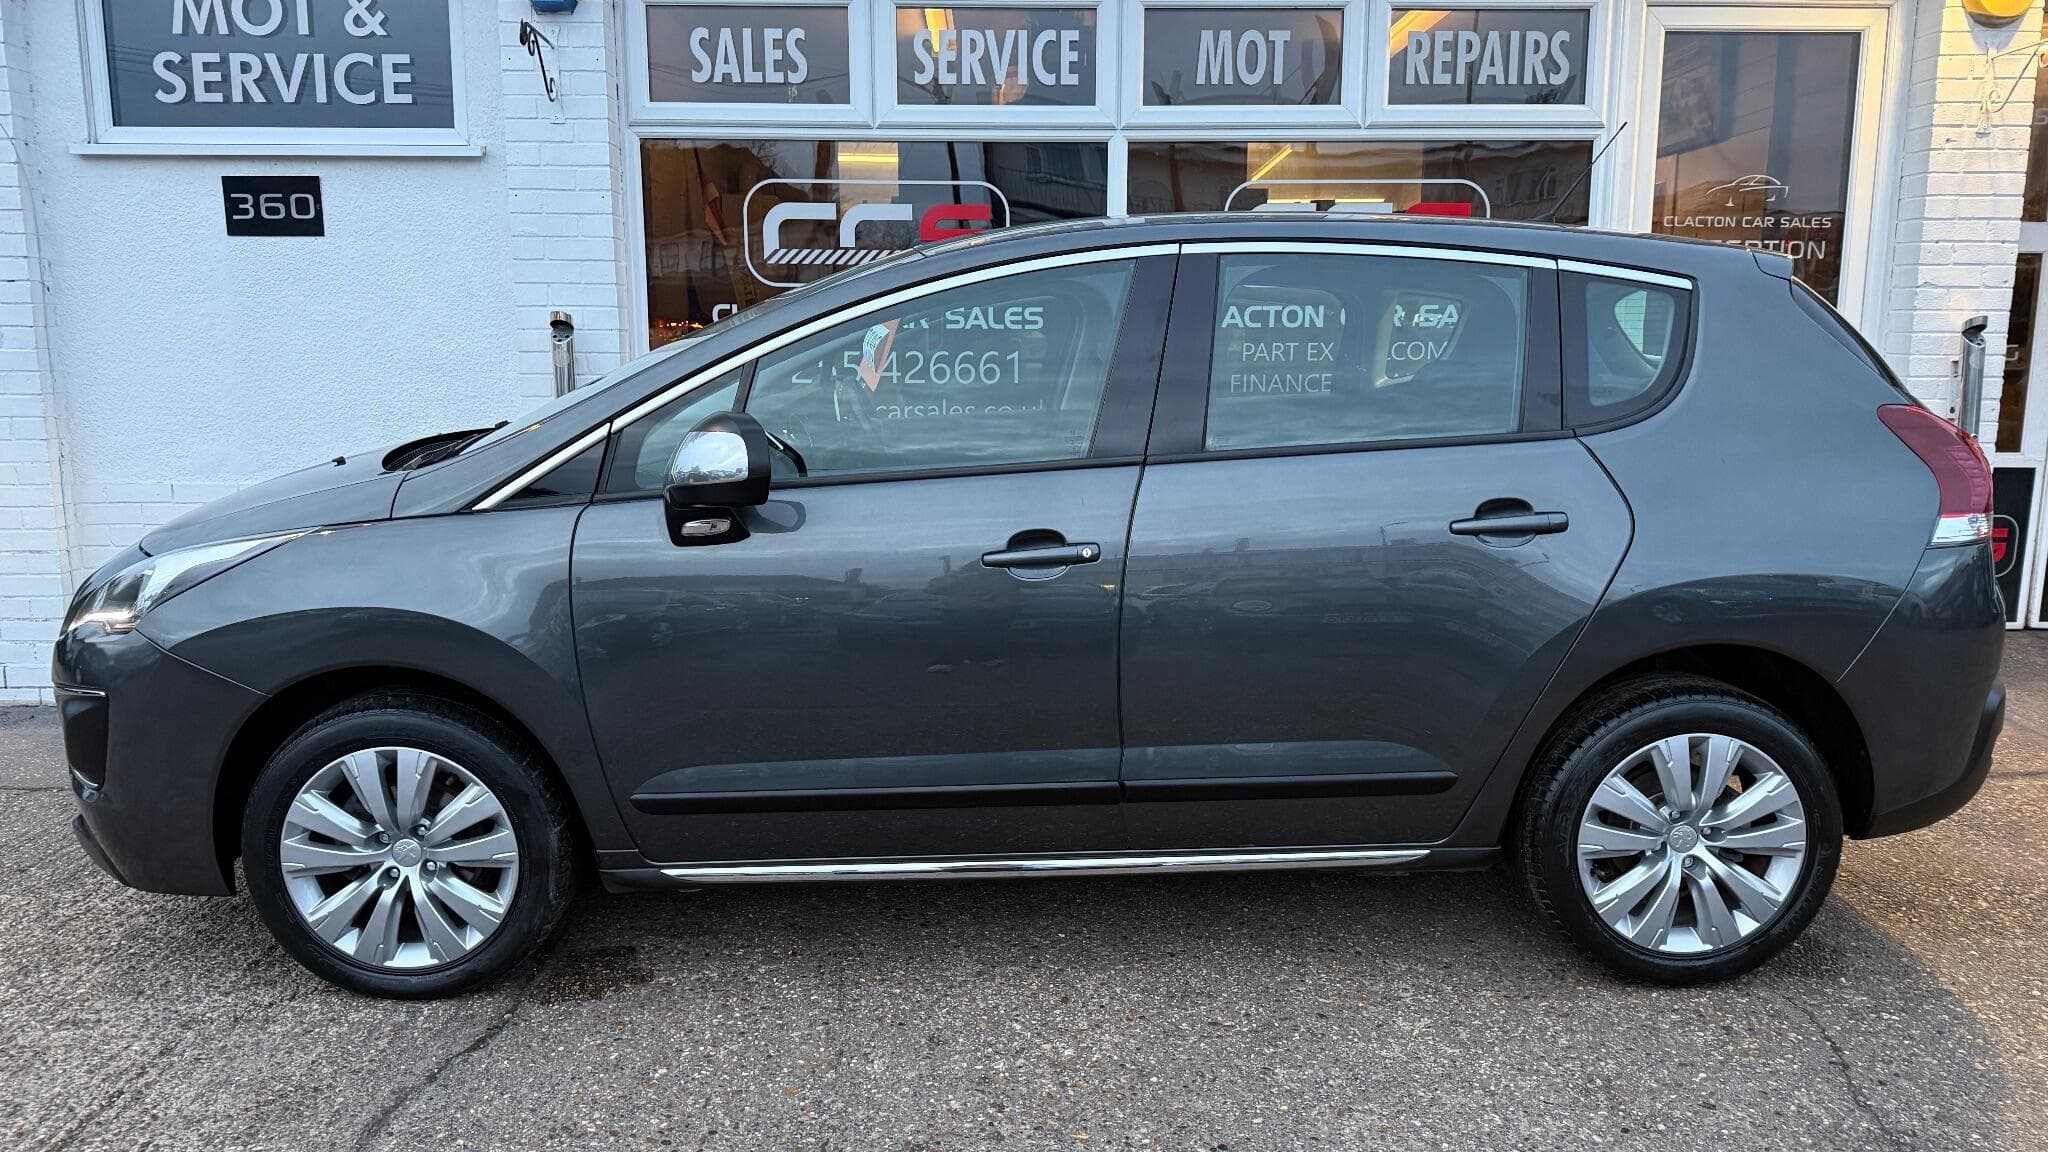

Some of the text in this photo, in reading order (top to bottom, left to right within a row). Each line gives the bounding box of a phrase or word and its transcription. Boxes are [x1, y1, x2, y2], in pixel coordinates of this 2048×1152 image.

[171, 0, 388, 37] MOT &
[689, 27, 808, 84] SALES
[913, 29, 1080, 86] SERVICE
[1196, 29, 1291, 85] MOT
[1405, 30, 1571, 85] REPAIRS
[152, 51, 413, 105] SERVICE
[230, 193, 316, 220] 360
[1663, 215, 1832, 229] CLACTON CAR SALES
[945, 306, 1044, 330] SALES
[880, 350, 1020, 384] 426661
[1242, 342, 1298, 362] PART
[1307, 342, 1334, 361] EX
[1230, 373, 1333, 393] FINANCE
